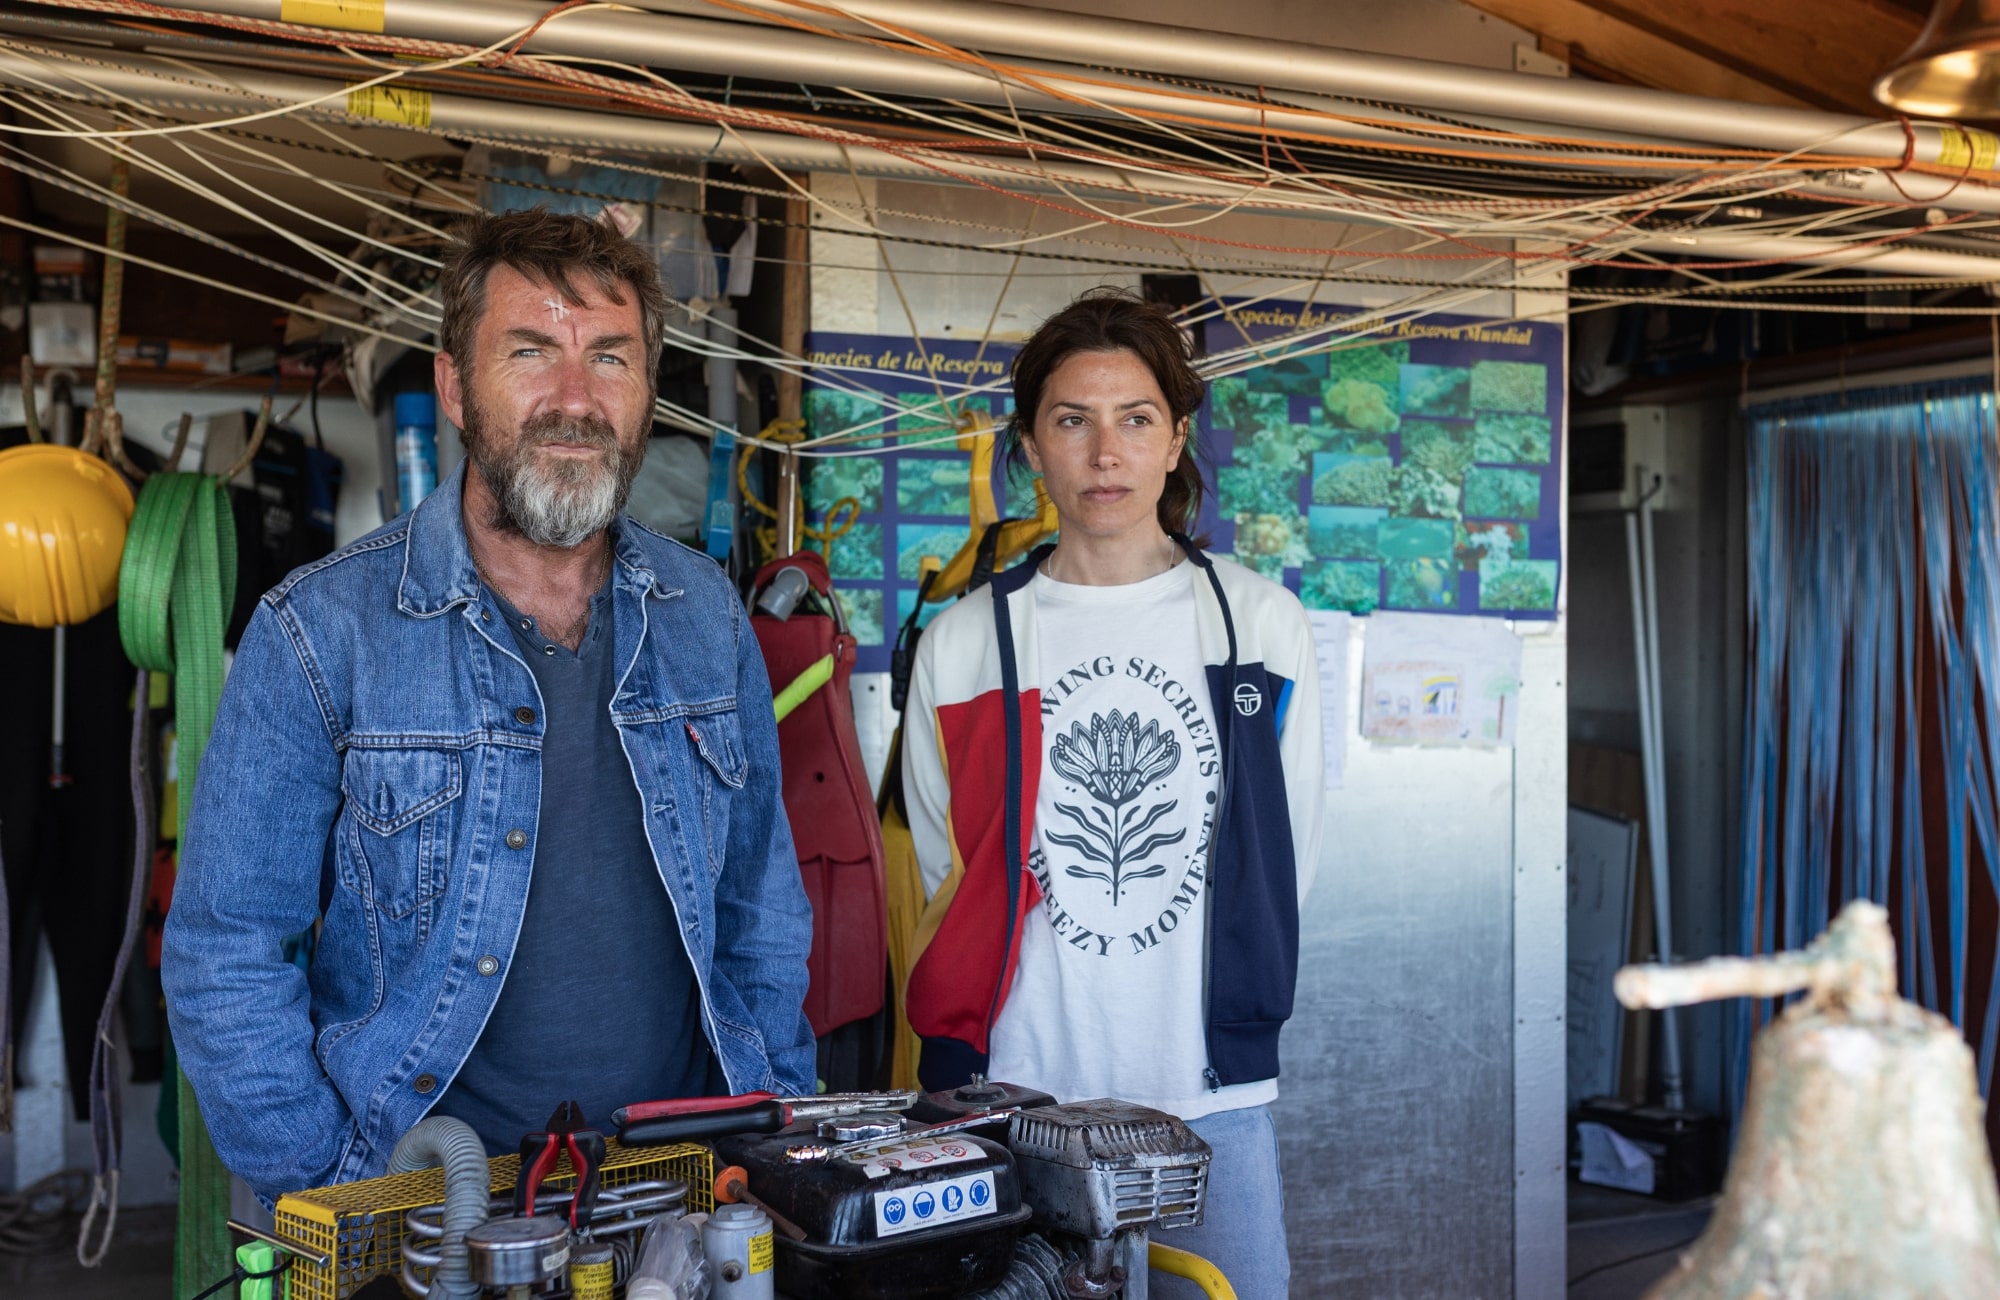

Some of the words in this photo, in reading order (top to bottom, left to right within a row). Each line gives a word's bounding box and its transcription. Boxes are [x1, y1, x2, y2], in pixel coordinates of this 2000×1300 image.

[1398, 319, 1461, 341] Reserva
[1465, 323, 1533, 346] Mundial
[877, 350, 900, 371] de
[905, 352, 924, 371] la
[930, 353, 1004, 375] Reserva
[1126, 656, 1220, 778] SECRETS
